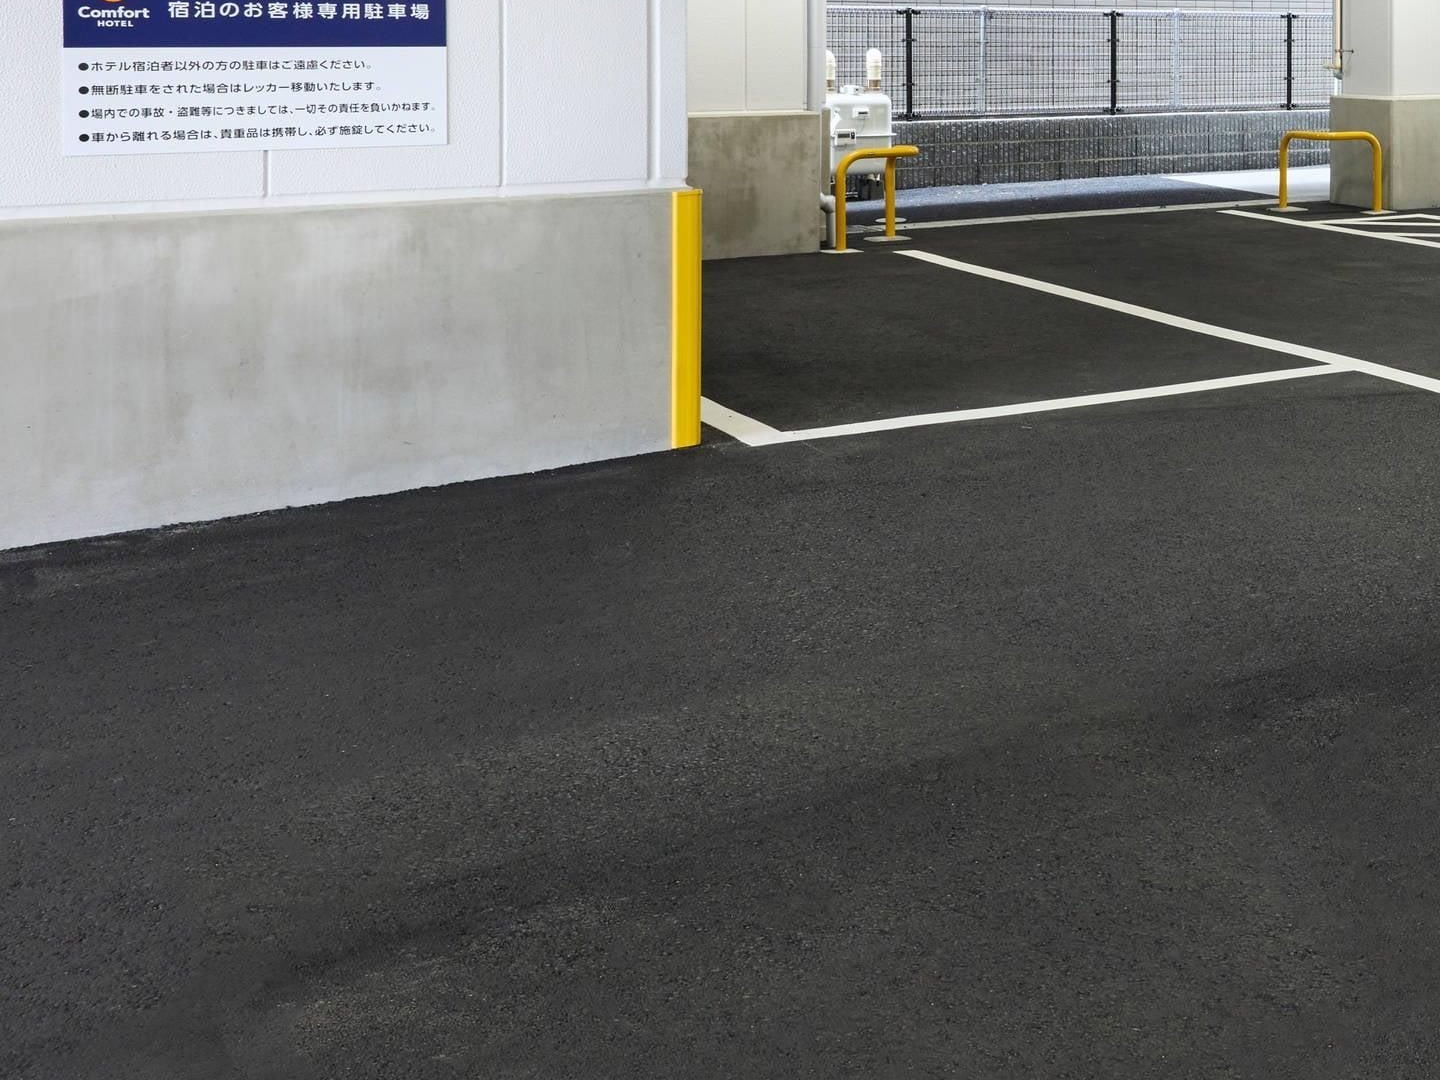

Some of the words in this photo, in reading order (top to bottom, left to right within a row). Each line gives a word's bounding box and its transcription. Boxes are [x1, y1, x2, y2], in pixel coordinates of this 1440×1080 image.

[77, 5, 150, 19] Comfort
[167, 1, 430, 20] 宿泊のお客様専用駐車場
[97, 20, 134, 28] HOTEL
[91, 60, 373, 72] ホテル宿泊者以外の方の駐車はご遠慮ください。
[91, 82, 381, 96] 無断駐車をされた場合はレッカー移動いたします。
